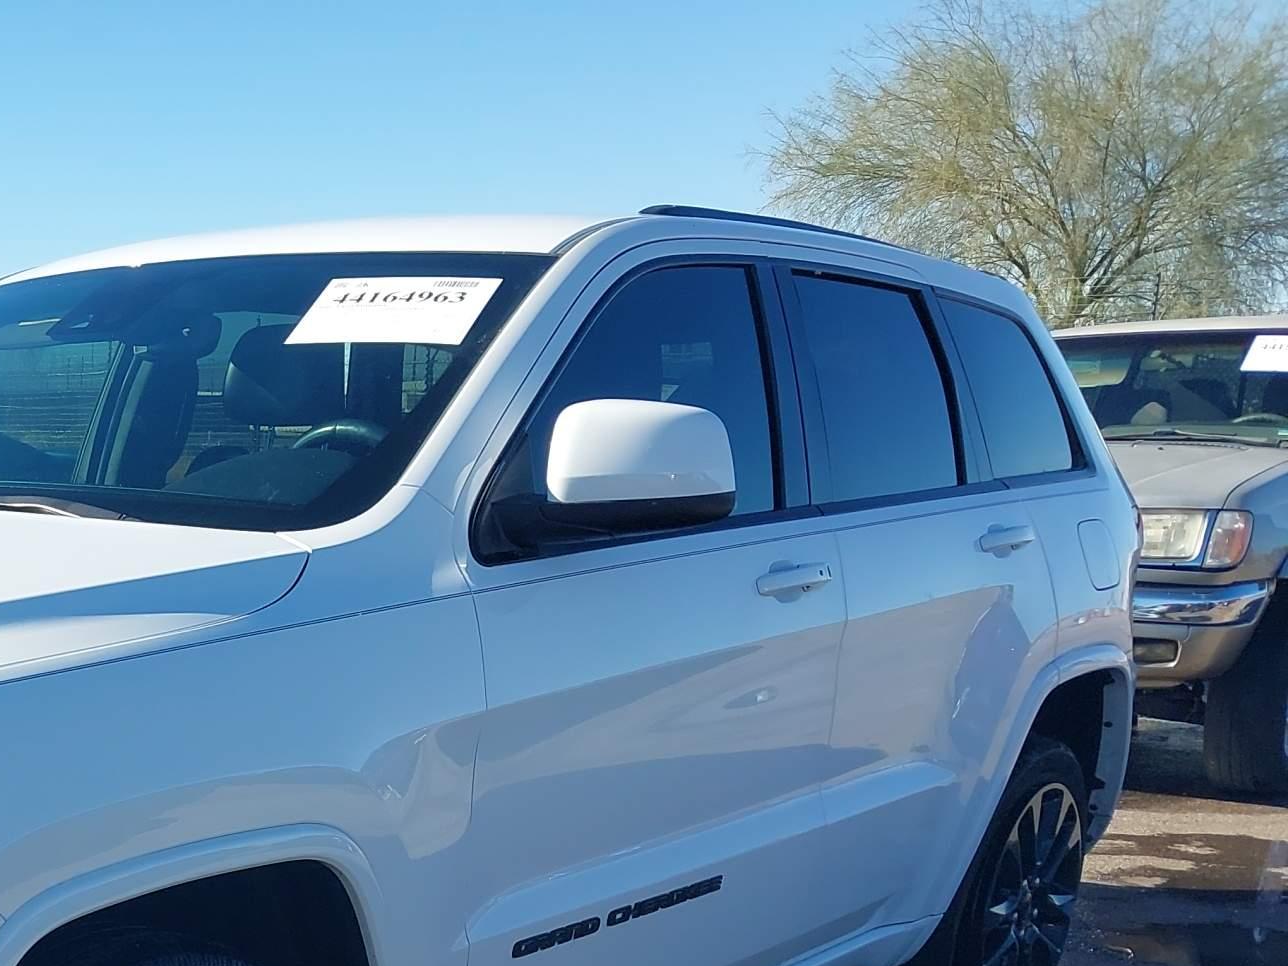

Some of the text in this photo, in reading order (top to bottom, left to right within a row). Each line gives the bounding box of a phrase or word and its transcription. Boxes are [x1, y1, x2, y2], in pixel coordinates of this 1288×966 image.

[333, 290, 467, 304] 44164963
[511, 874, 724, 959] GRAND CHEROKEE
